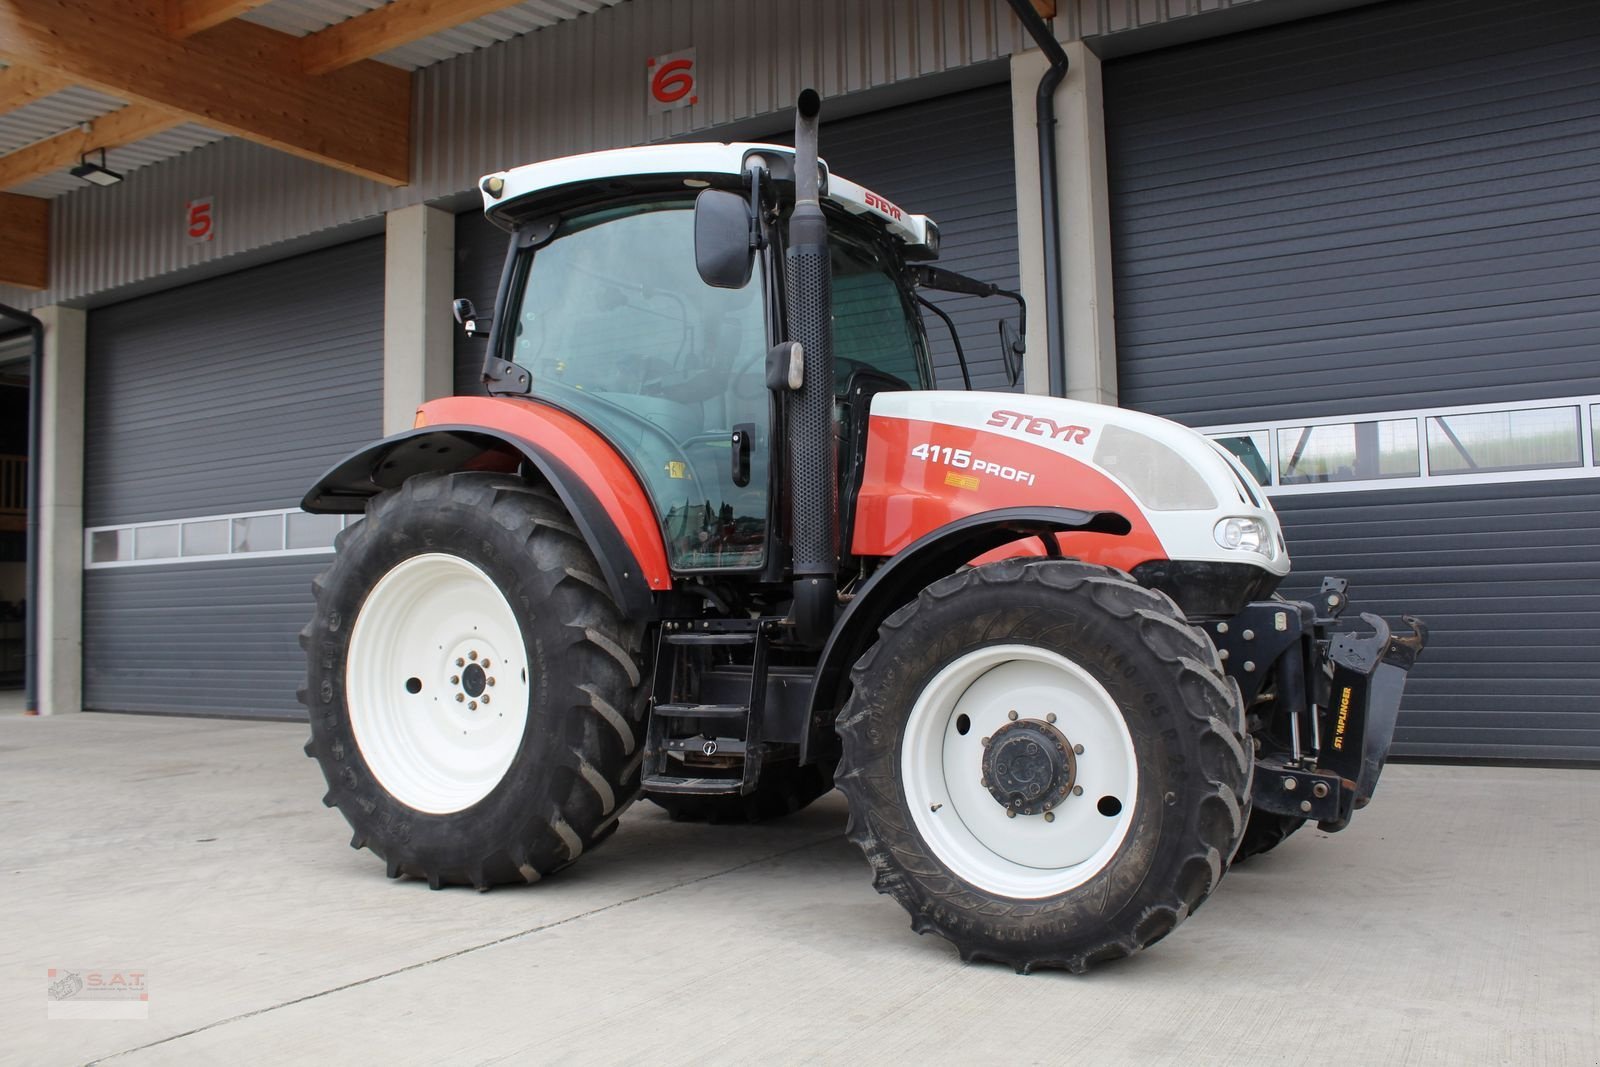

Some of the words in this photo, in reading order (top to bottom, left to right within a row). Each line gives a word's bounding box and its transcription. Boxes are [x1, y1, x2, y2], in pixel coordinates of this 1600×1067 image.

[651, 59, 694, 103] 6
[188, 203, 211, 237] 5
[865, 191, 902, 221] STEYR
[986, 409, 1091, 445] STEYR
[911, 443, 972, 469] 4115
[971, 459, 1036, 487] PROFI
